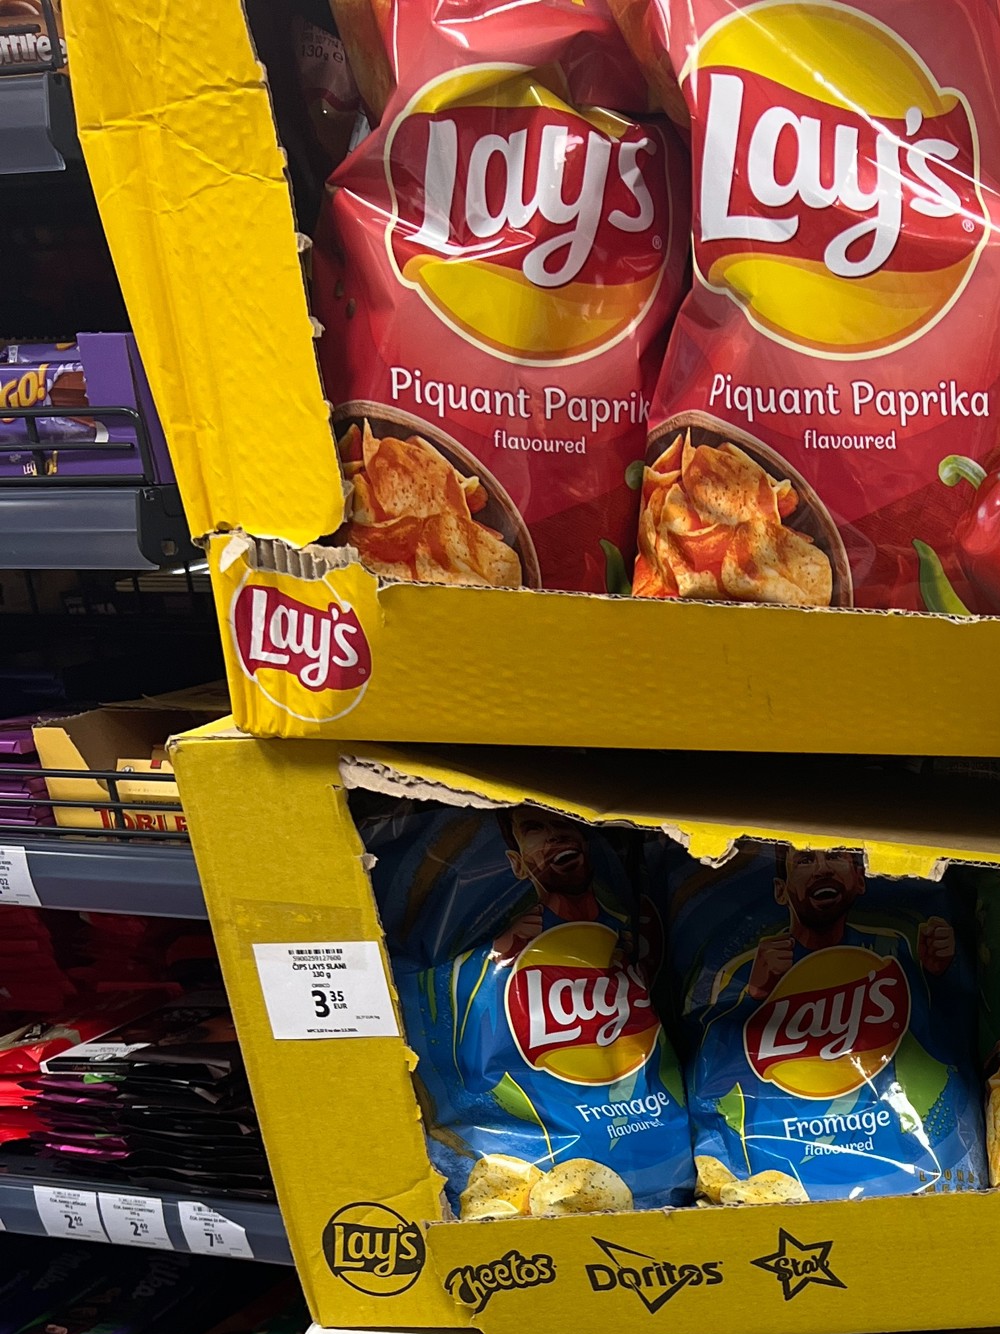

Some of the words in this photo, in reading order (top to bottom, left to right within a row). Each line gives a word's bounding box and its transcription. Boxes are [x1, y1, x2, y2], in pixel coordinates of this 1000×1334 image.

[701, 73, 959, 278] Lay's
[403, 119, 657, 287] Lay's
[390, 367, 531, 419] Piquant
[544, 387, 651, 425] Paprik
[709, 373, 839, 421] Piquant
[851, 381, 990, 426] Paprika
[494, 430, 586, 455] flavoured
[804, 429, 897, 451] flavoured
[250, 589, 359, 689] Lay's
[292, 962, 308, 970] ČIPS
[311, 990, 330, 1018] 3
[329, 990, 344, 1002] 35
[526, 963, 652, 1051] Lay's
[756, 972, 898, 1065] Lay's
[577, 1089, 670, 1123] Fromage
[607, 1117, 663, 1140] flavoured
[783, 1107, 890, 1138] Fromage
[805, 1137, 873, 1158] flavoured
[64, 1214, 77, 1229] 2
[130, 1221, 142, 1236] 2
[205, 1233, 213, 1247] 7
[333, 1222, 419, 1277] Lay's
[445, 1252, 555, 1312] Cheetos
[586, 1258, 723, 1292] Doritos
